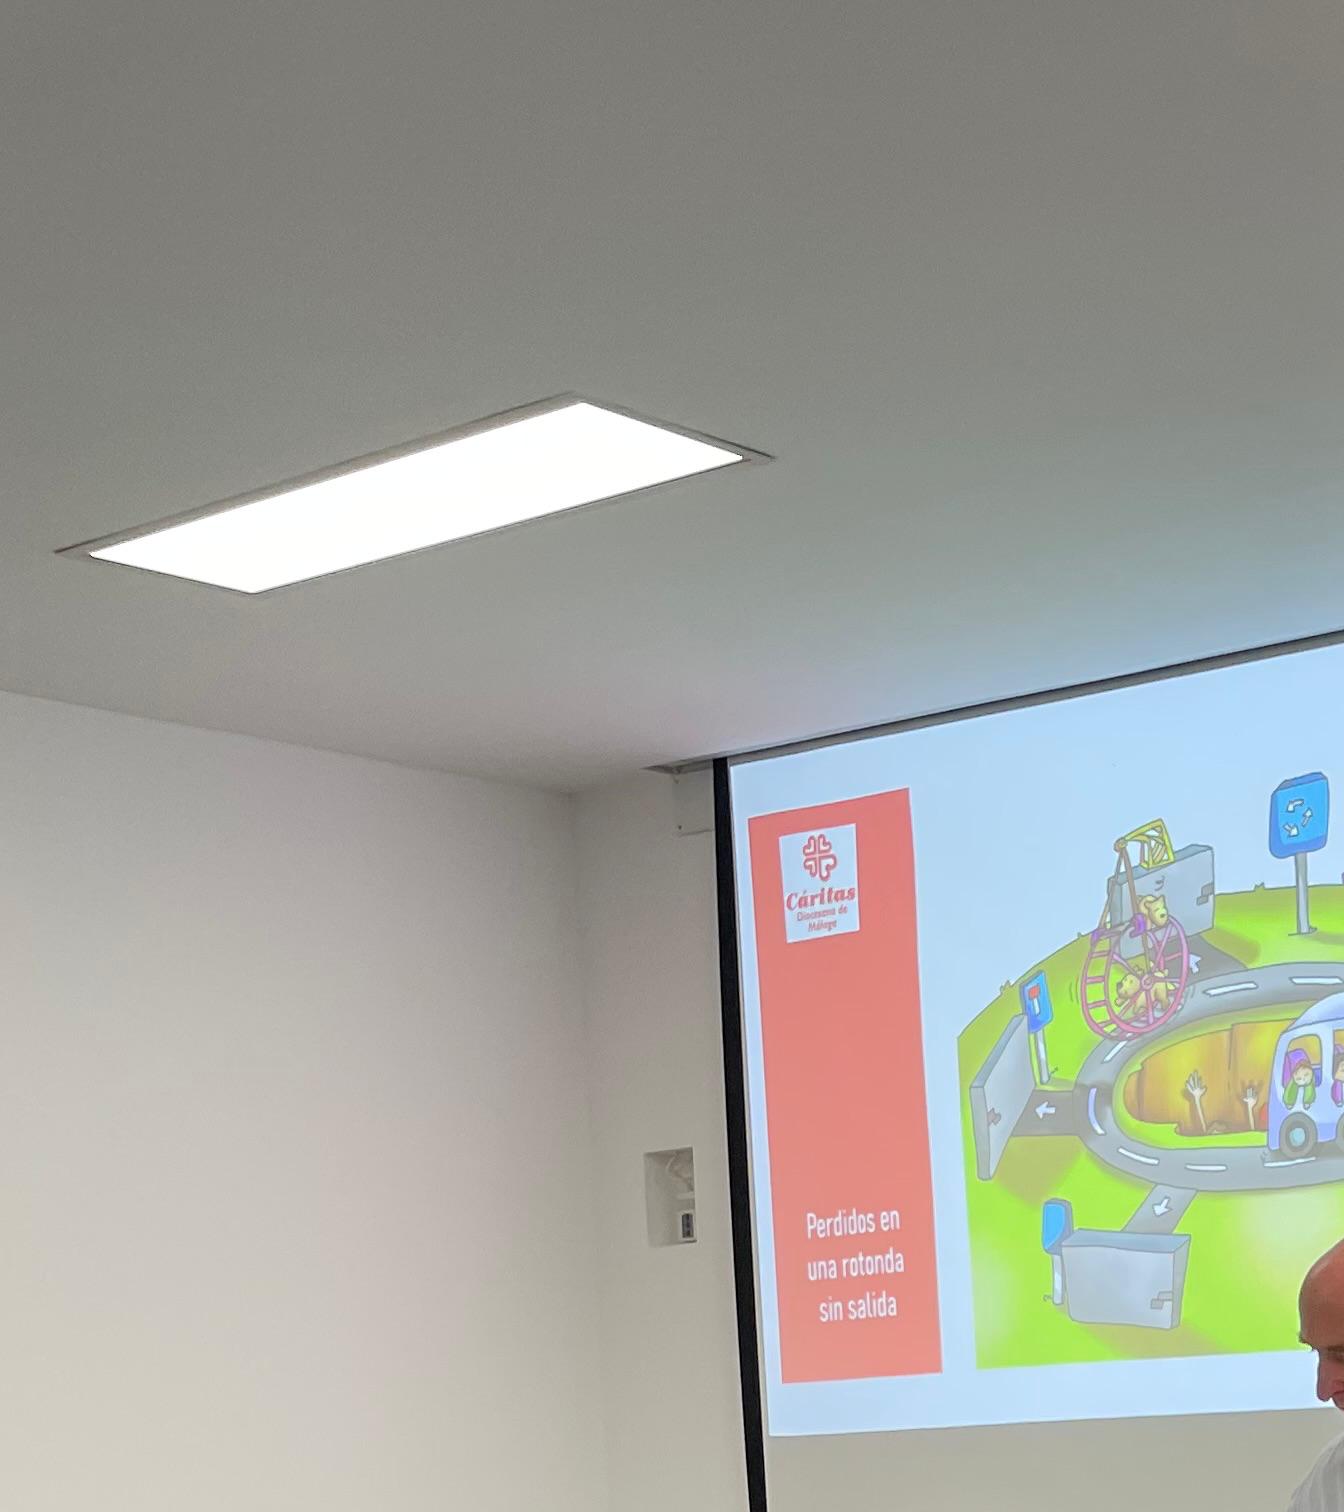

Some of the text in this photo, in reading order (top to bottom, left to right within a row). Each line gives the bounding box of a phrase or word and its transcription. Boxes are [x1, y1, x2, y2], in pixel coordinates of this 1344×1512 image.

[786, 887, 856, 911] Cáritas
[807, 1208, 900, 1239] Perdidos en
[808, 1247, 904, 1280] una rotonda
[819, 1291, 897, 1322] sin salida
